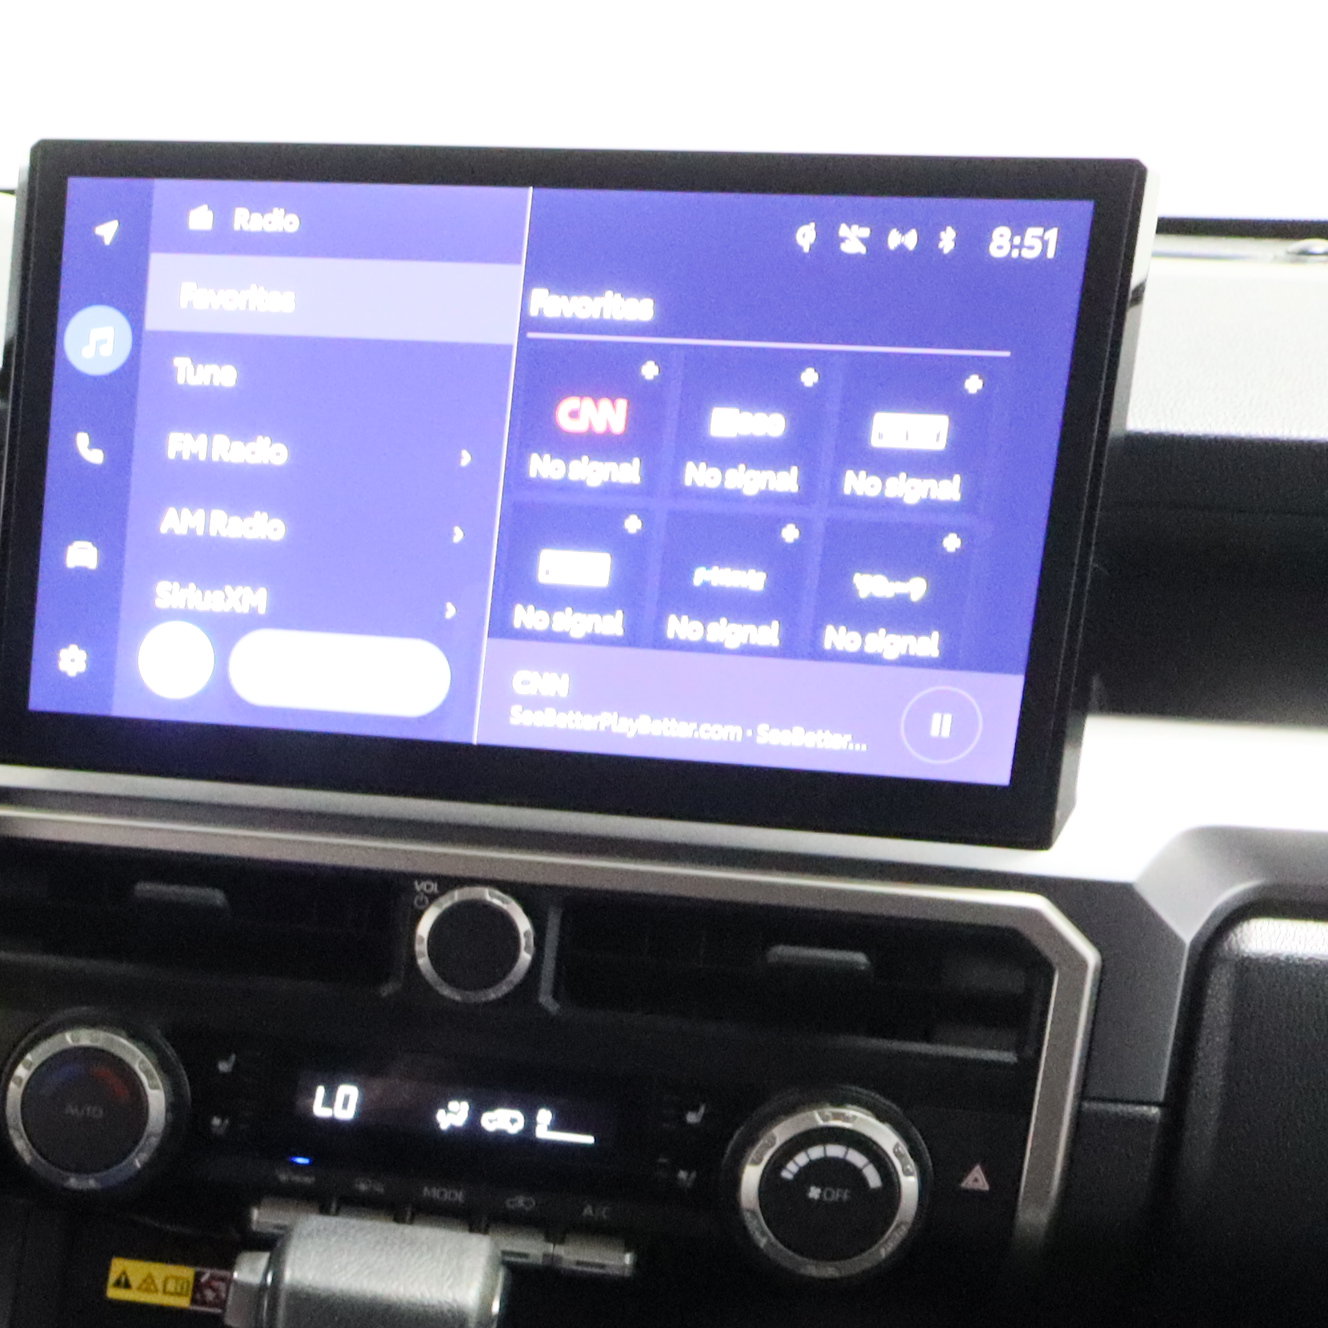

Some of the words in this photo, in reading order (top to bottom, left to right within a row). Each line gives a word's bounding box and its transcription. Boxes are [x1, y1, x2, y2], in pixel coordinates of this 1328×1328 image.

[233, 206, 300, 234] Radio
[988, 225, 1059, 260] 8:51
[178, 281, 297, 314] Favorites
[529, 287, 655, 321] Favorites
[173, 357, 238, 388] Tune
[554, 395, 629, 435] CNN
[167, 432, 208, 462] FM
[211, 433, 289, 466] Radio
[528, 453, 566, 481] No
[567, 457, 641, 488] signal
[684, 460, 723, 488] No
[724, 464, 799, 496] signal
[843, 469, 882, 498] No
[884, 473, 962, 504] signal
[159, 507, 206, 536] AM
[209, 508, 286, 542] Radio
[155, 581, 269, 615] SiriusXM
[513, 603, 549, 631] No
[550, 607, 625, 639] signal
[666, 614, 704, 642] No
[705, 618, 781, 650] signal
[823, 624, 862, 652] No
[864, 628, 940, 660] signal
[511, 669, 570, 698] CNN
[414, 880, 439, 894] VOL
[423, 1186, 466, 1203] MODE
[822, 1188, 851, 1202] OFF
